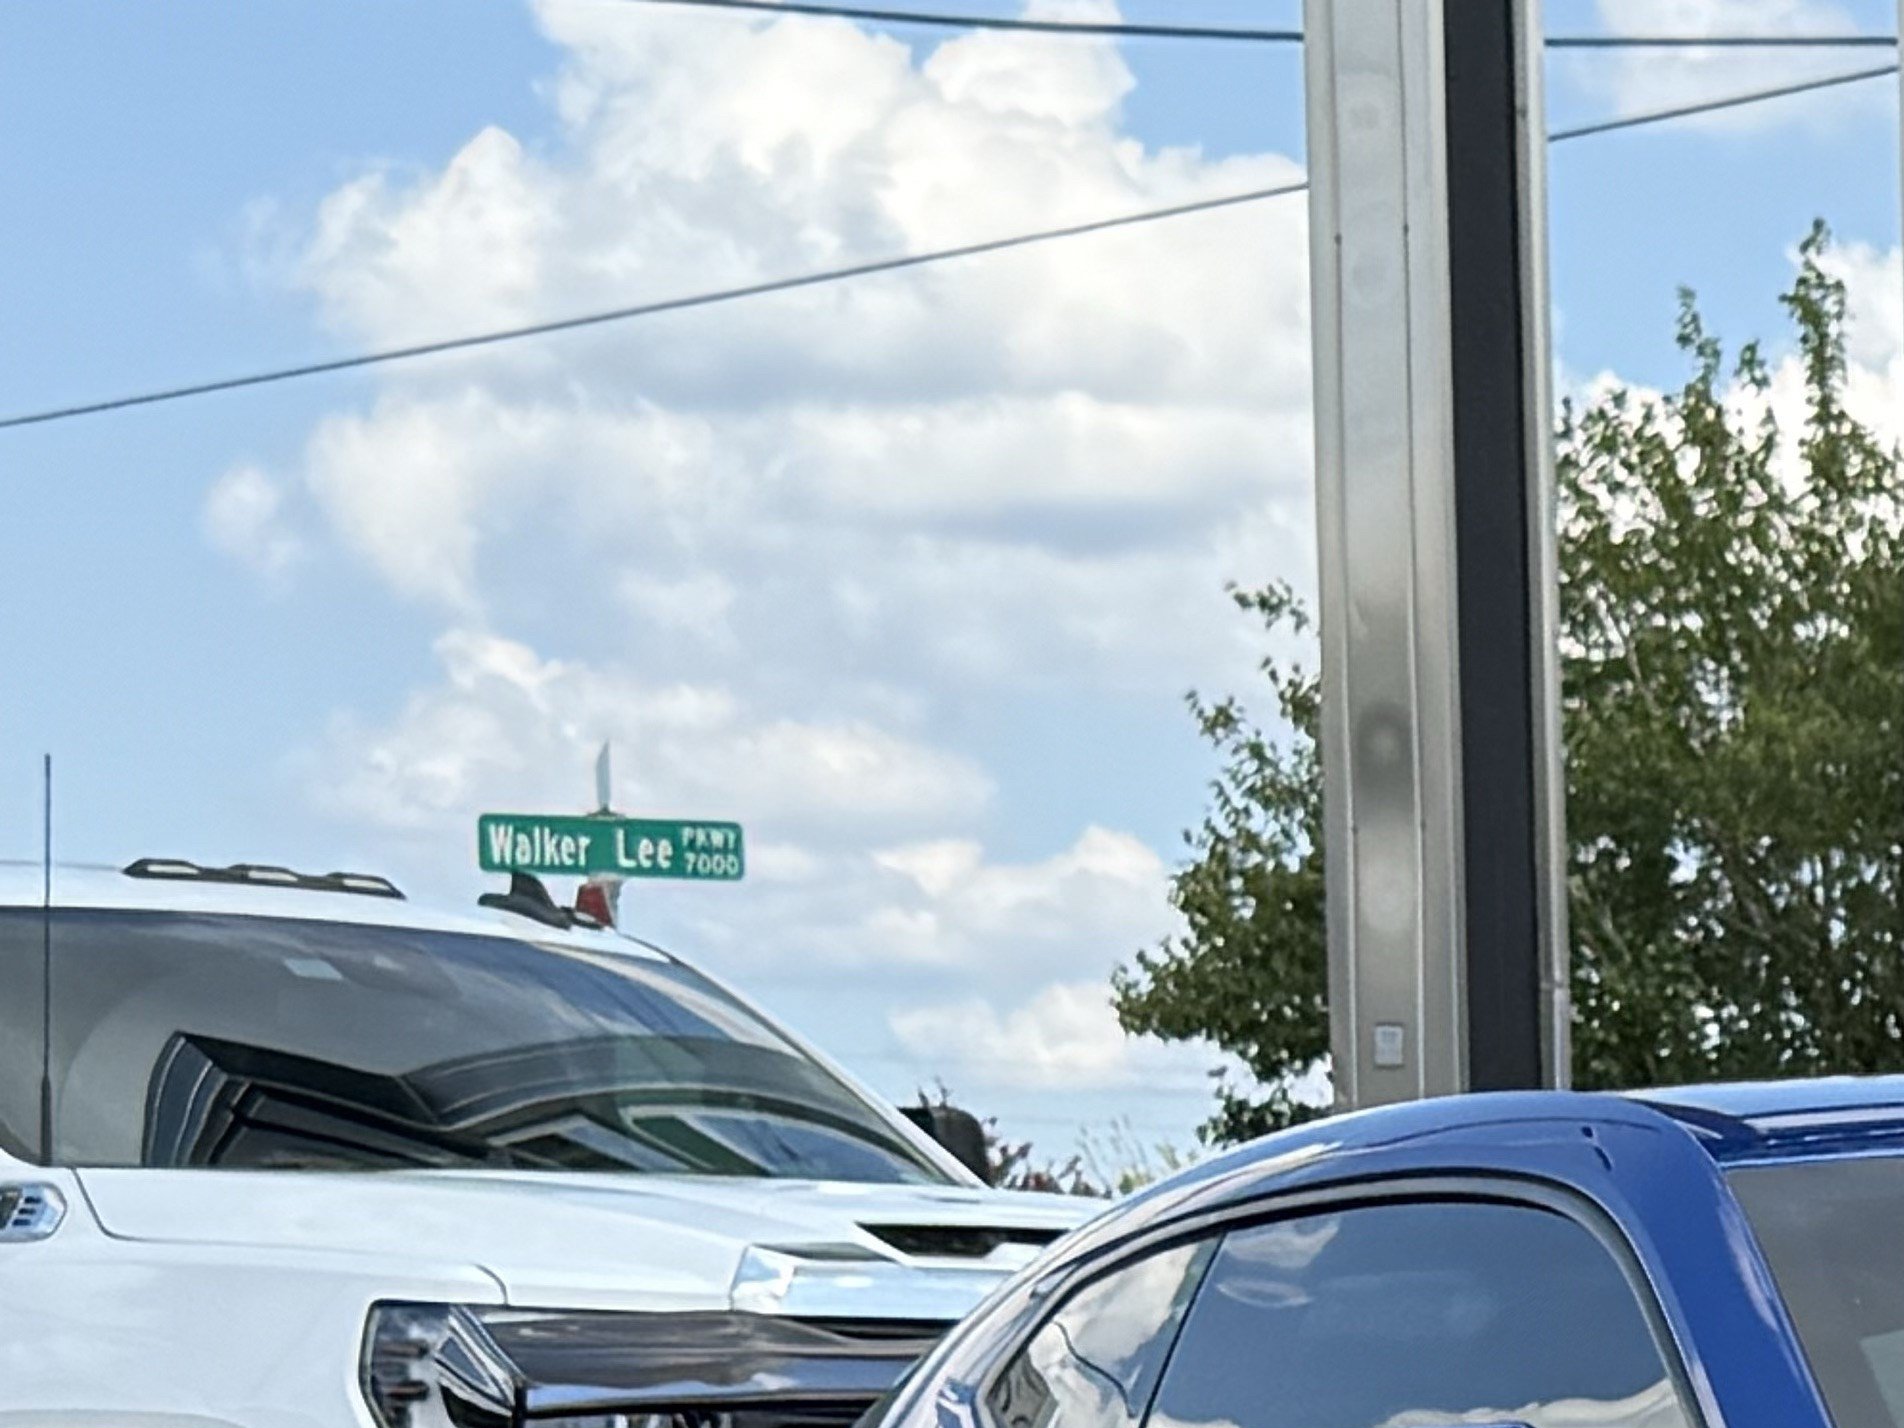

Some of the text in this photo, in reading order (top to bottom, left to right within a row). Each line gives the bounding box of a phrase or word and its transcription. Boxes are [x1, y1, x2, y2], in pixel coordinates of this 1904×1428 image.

[488, 824, 674, 868] Walker Lee
[684, 852, 739, 874] 7000
